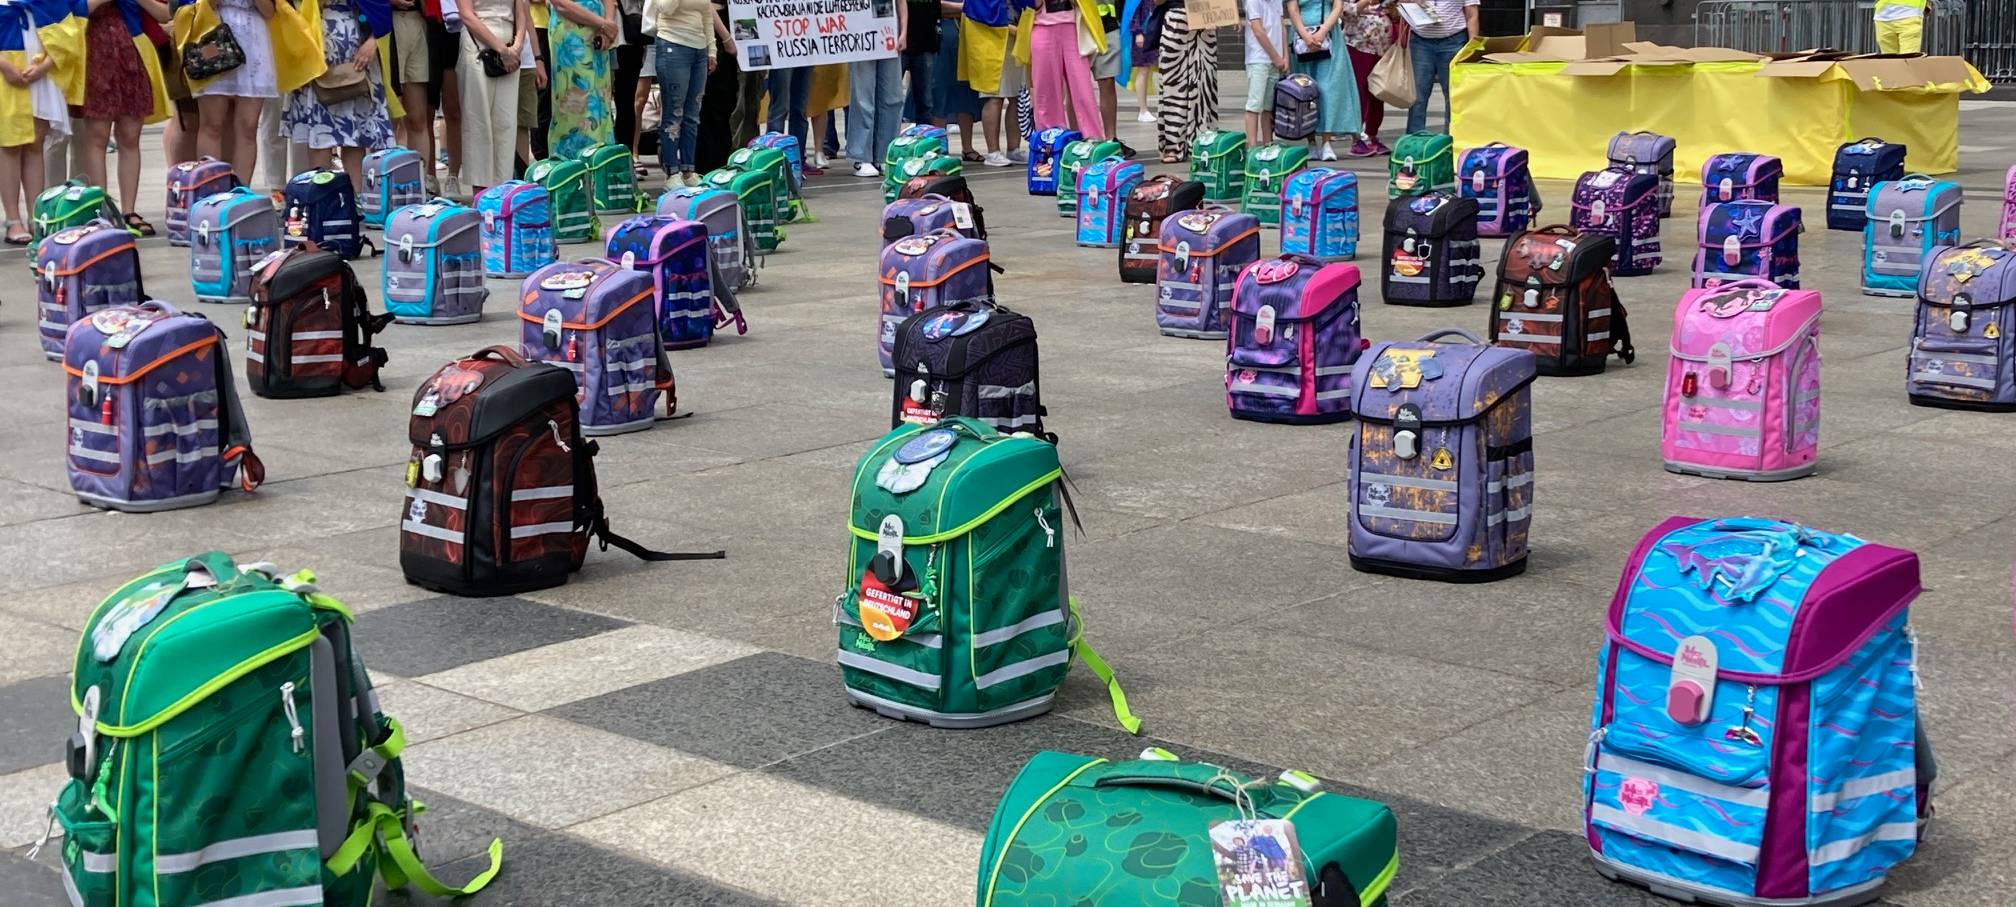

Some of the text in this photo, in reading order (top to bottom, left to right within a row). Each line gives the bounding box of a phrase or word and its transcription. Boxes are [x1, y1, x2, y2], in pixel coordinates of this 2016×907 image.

[774, 14, 847, 38] STOP WAR
[777, 31, 878, 58] RUSSIA TERRORIST
[865, 587, 913, 609] GEFERTIGT IN
[1233, 870, 1290, 886] SAVE THE
[1225, 880, 1304, 902] PLANET
